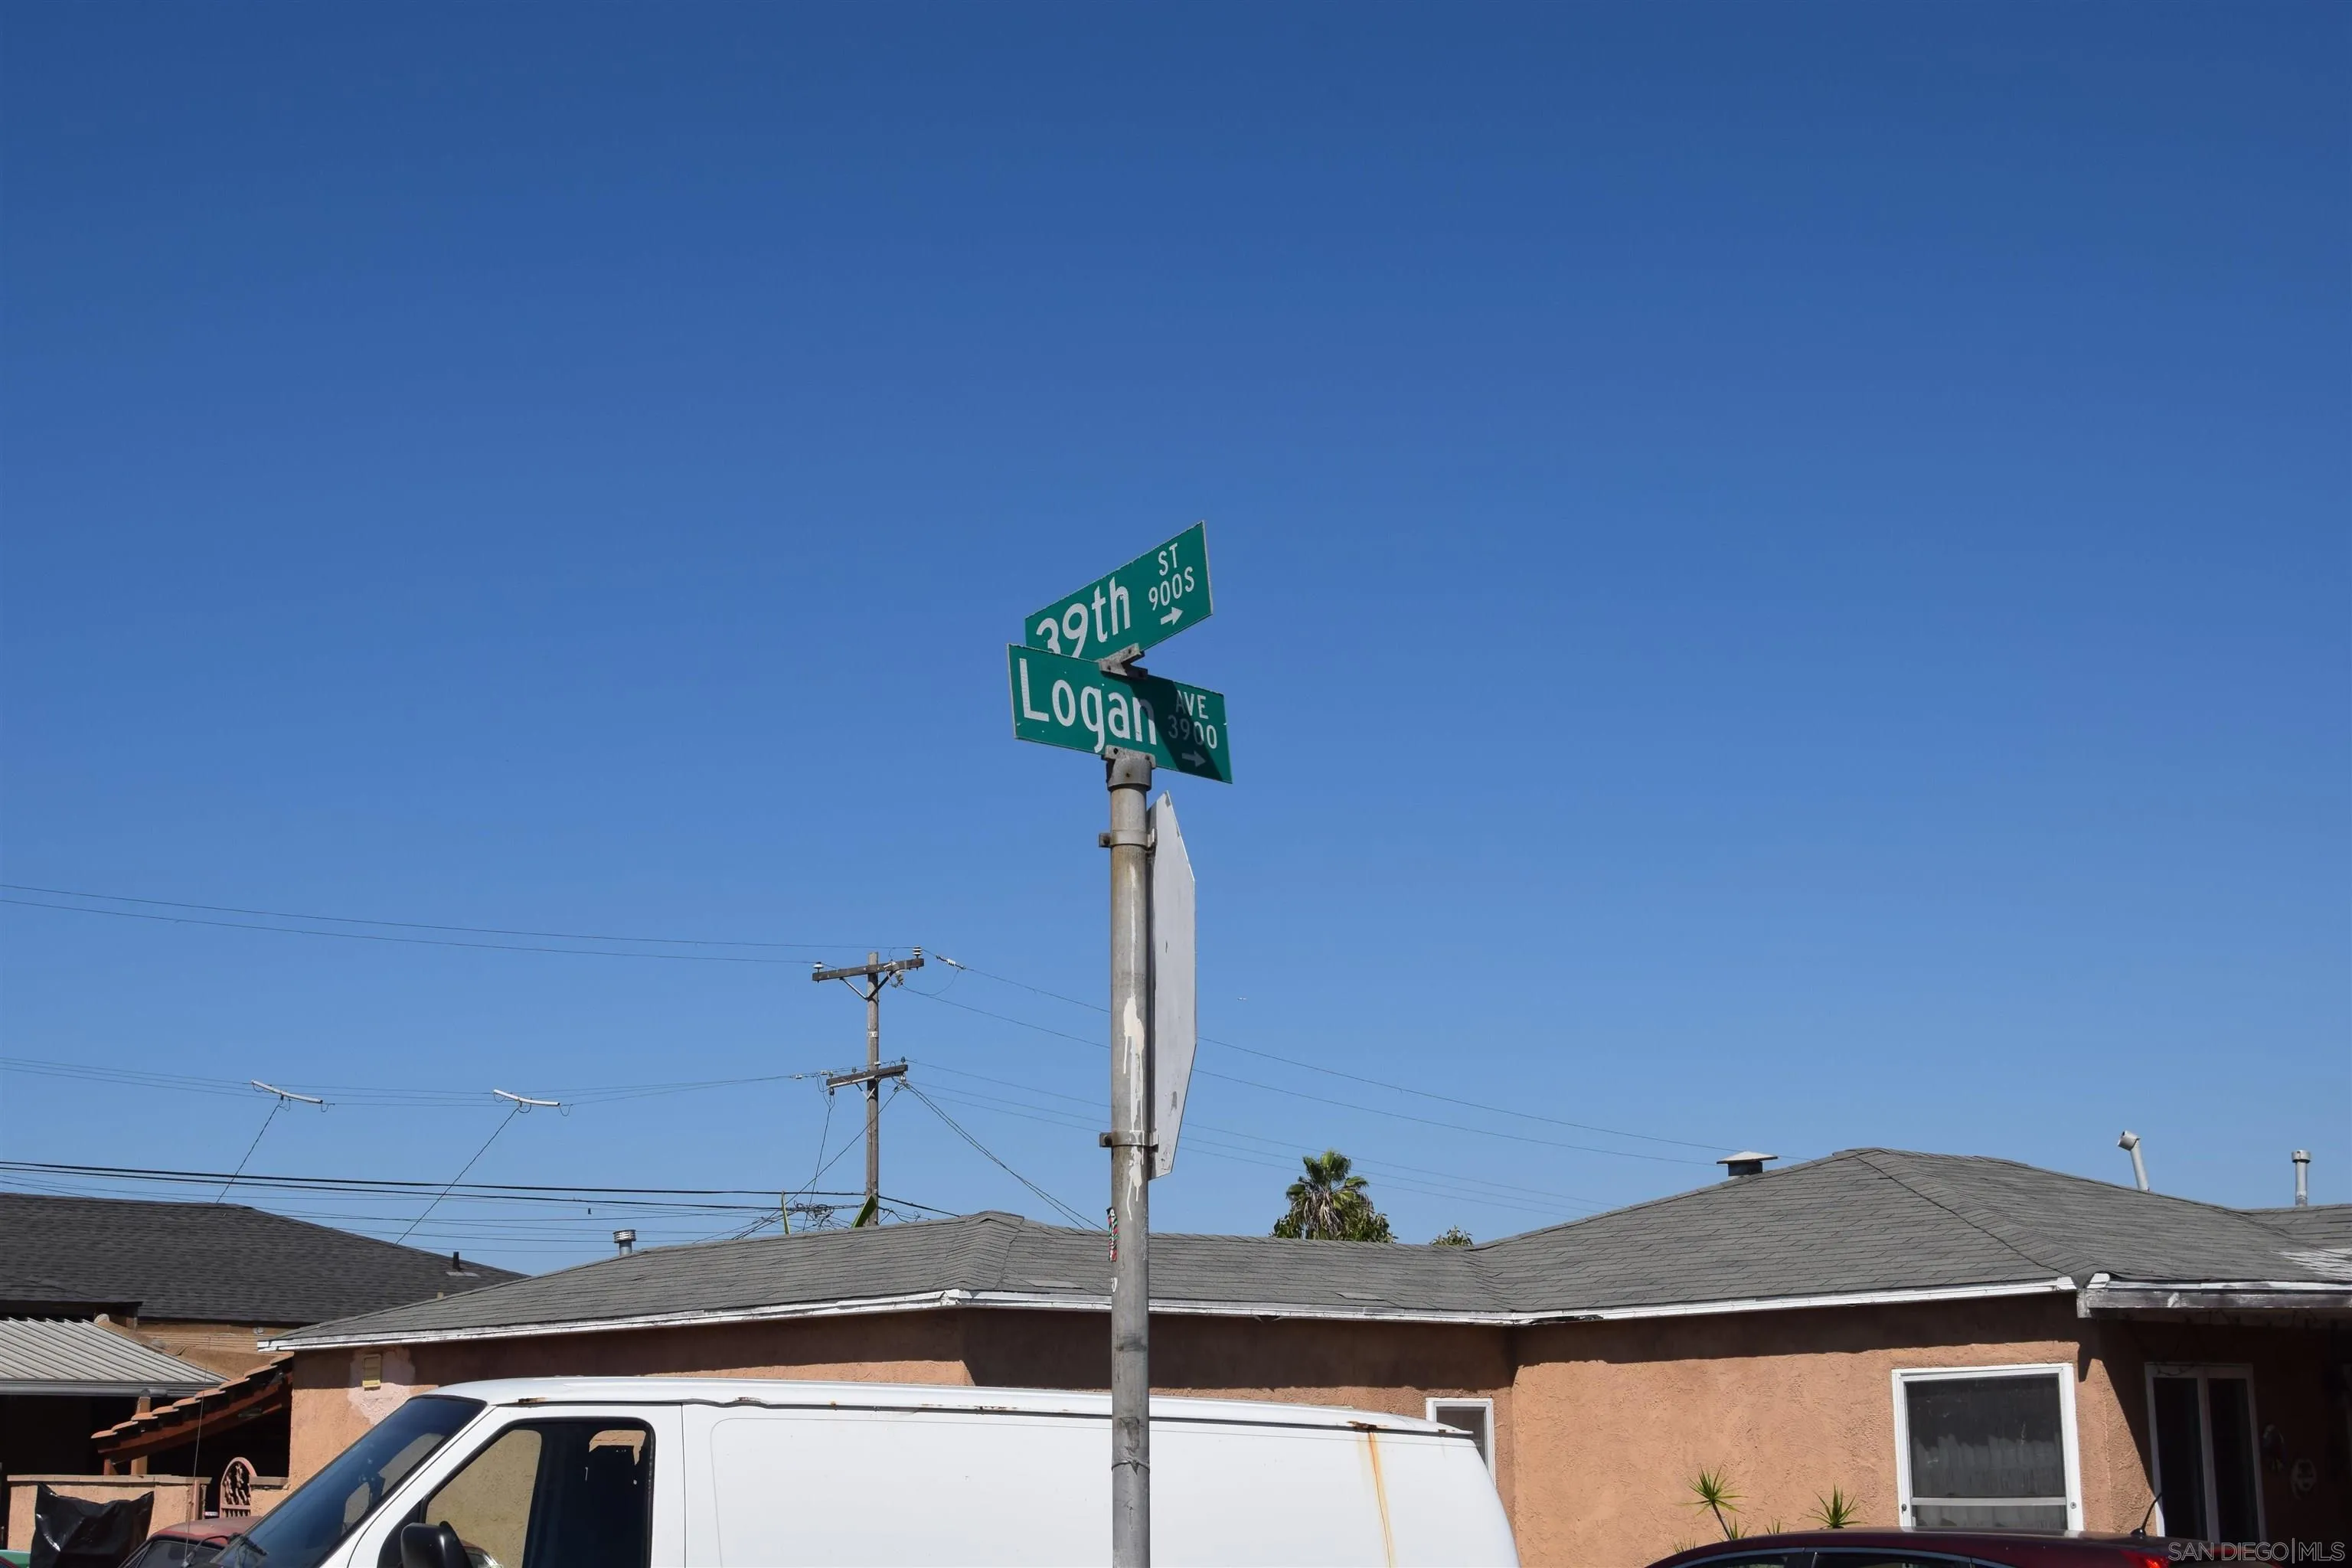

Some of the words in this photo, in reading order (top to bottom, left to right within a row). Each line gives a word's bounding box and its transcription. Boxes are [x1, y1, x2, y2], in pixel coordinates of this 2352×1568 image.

[1158, 543, 1178, 576] ST
[1148, 566, 1194, 611] 900S
[1036, 577, 1131, 658] 39th
[1019, 658, 1157, 753] Logan
[1176, 690, 1209, 719] AVE
[1168, 714, 1217, 750] 3900
